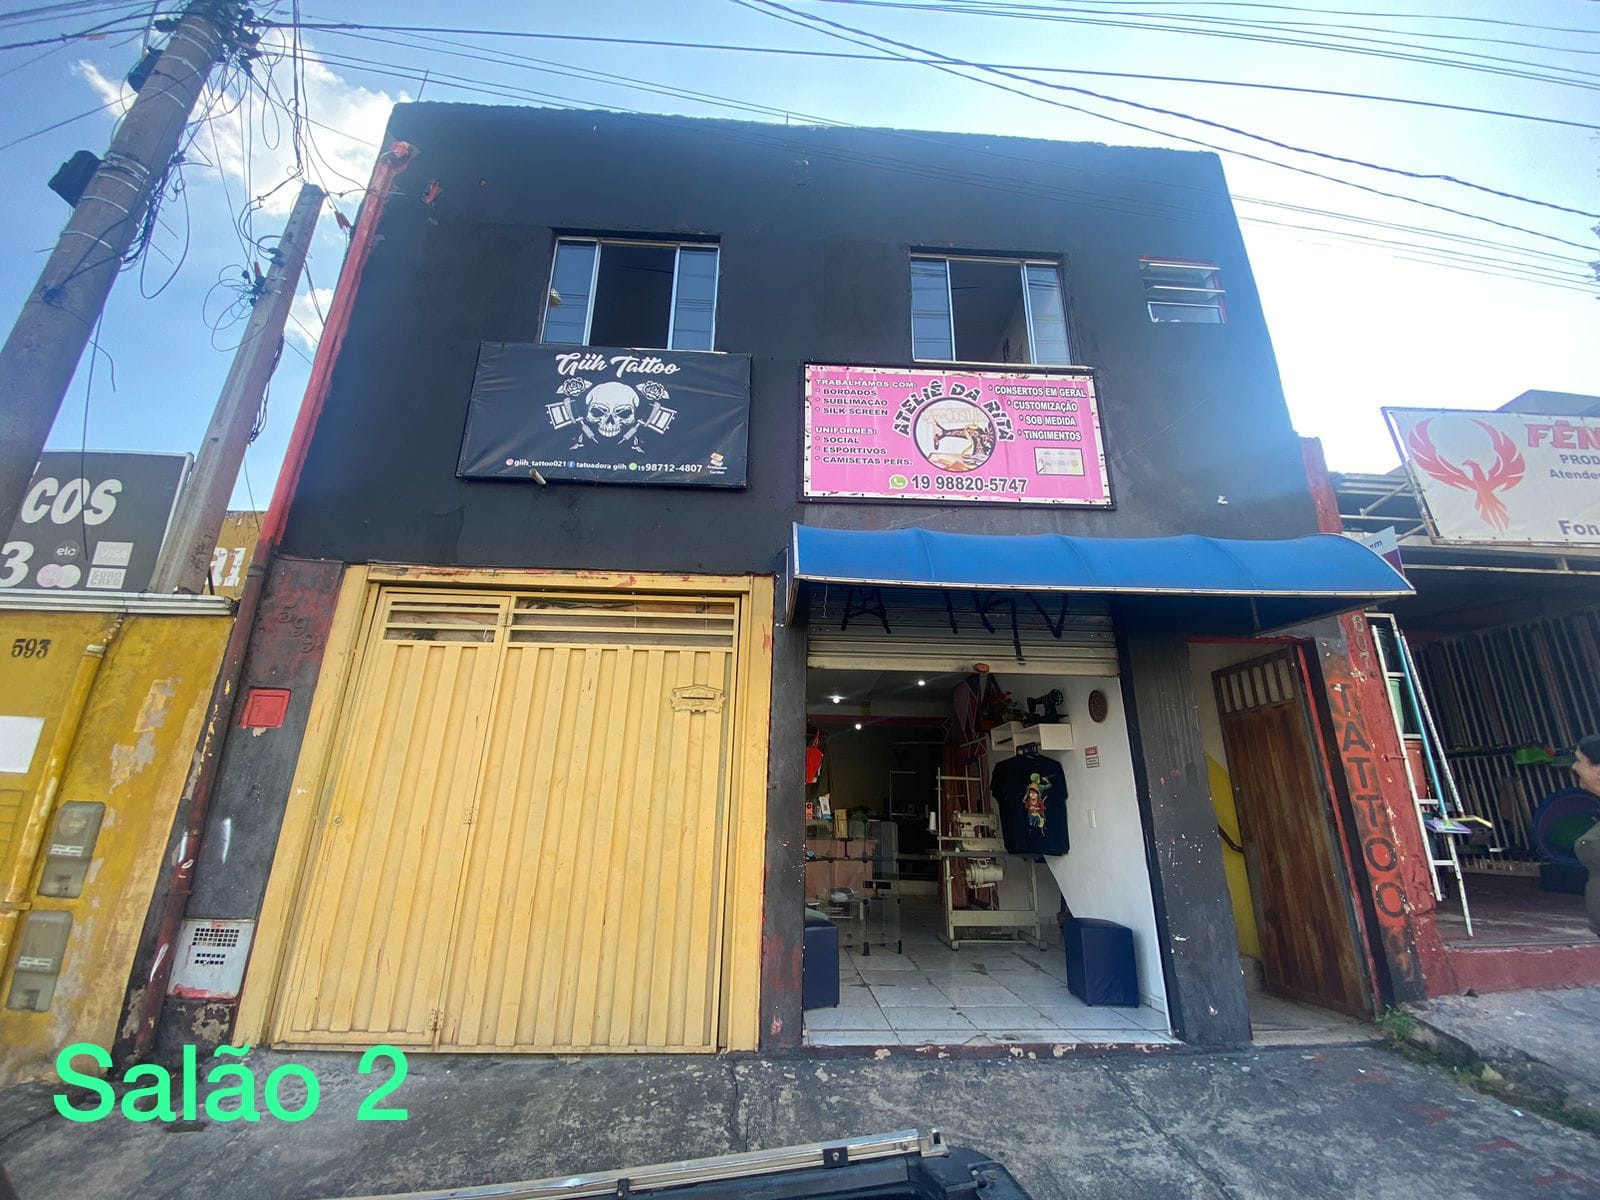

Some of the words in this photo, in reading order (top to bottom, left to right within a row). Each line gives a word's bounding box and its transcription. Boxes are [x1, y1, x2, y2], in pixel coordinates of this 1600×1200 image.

[556, 353, 607, 376] Giih
[610, 356, 681, 378] Tattoo
[815, 379, 889, 388] TRABALHAMOS
[892, 381, 917, 389] COM:
[823, 388, 877, 396] BORDADOS
[994, 385, 1044, 396] CONSERTOS
[1045, 386, 1058, 397] EM
[1059, 388, 1087, 398] GERAL
[950, 383, 981, 402] DA
[982, 400, 1014, 441] RITA
[1013, 400, 1078, 413] CUSTOMIZAÇÃO
[1025, 415, 1043, 425] SOB
[1044, 416, 1077, 426] MEDIDA
[823, 436, 860, 444] SOCIAL
[1023, 429, 1082, 441] TINGIMENTOS
[823, 456, 881, 464] CAMISETAS
[576, 462, 611, 470] tatuadora
[646, 463, 703, 473] 98712-4807
[912, 475, 931, 490] 19
[936, 476, 1027, 492] 98820-5747
[0, 541, 34, 588] 3
[11, 638, 52, 659] 593
[1330, 683, 1408, 918] TATTOO
